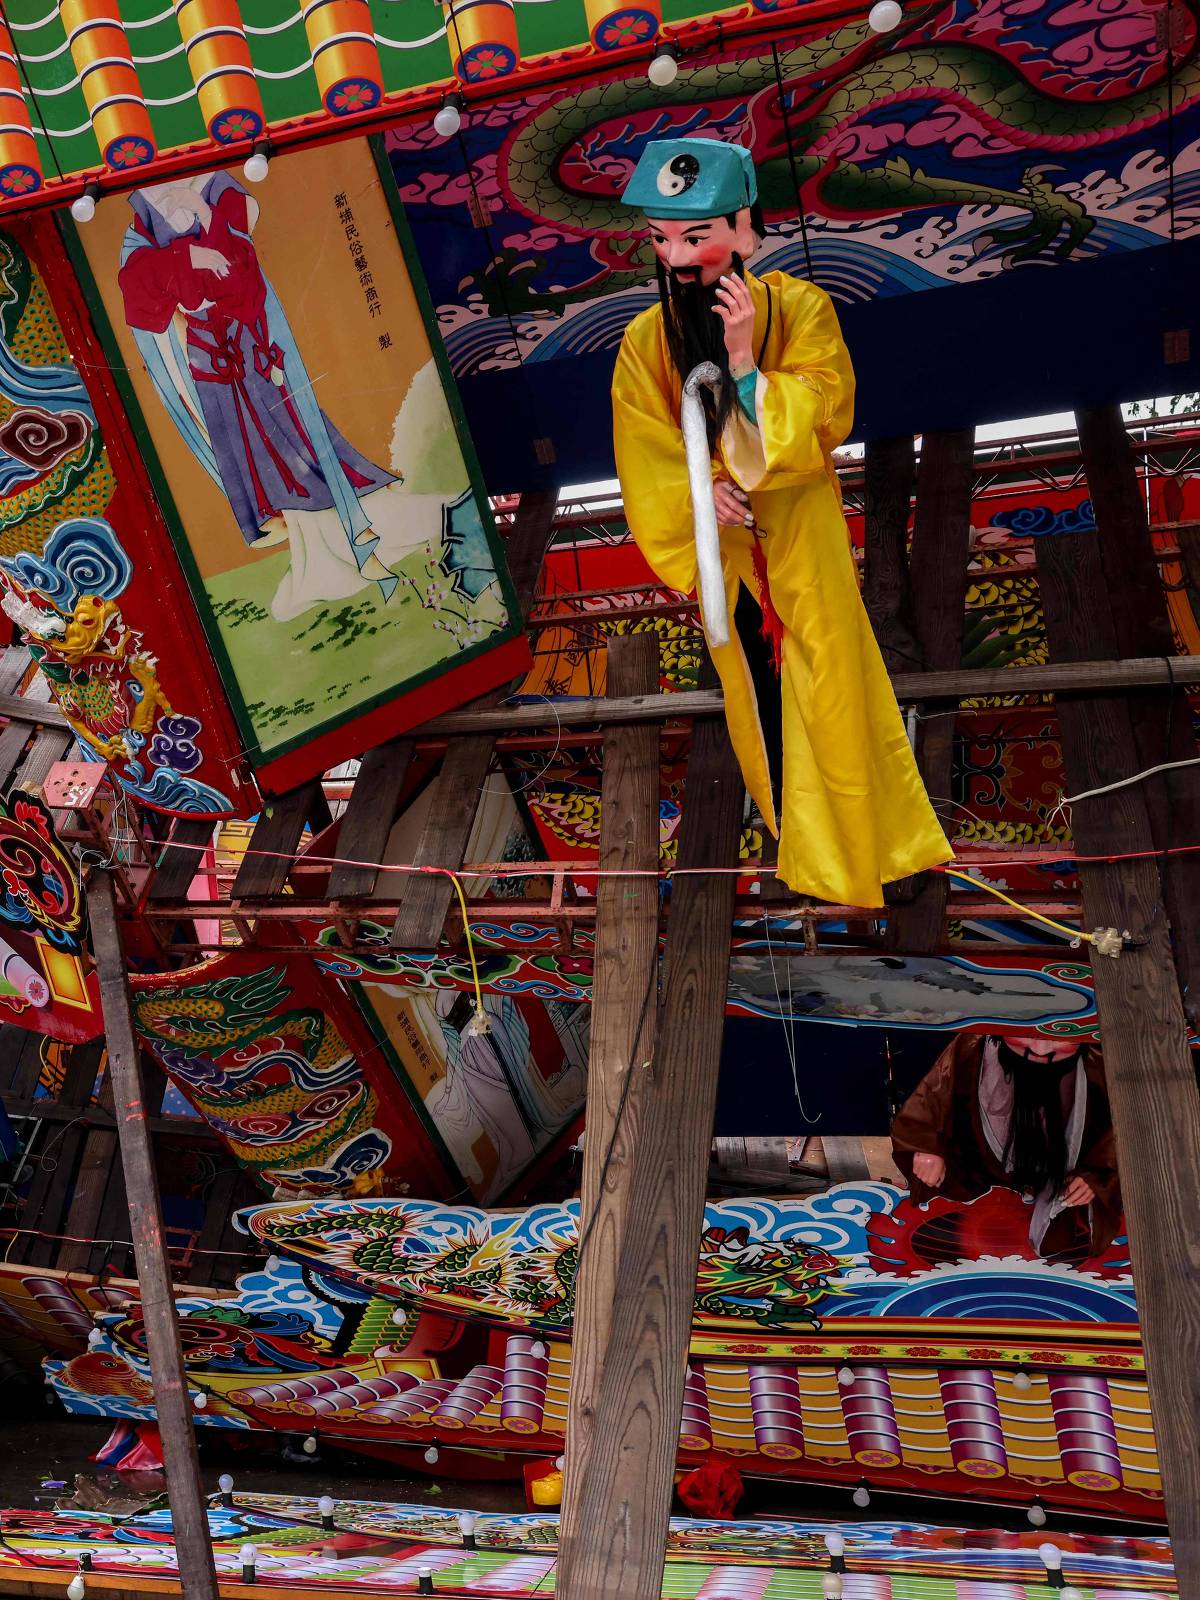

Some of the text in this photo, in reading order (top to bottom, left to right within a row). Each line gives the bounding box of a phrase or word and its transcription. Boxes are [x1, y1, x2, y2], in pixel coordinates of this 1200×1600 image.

[334, 192, 392, 351] 新埔民俗藝術商行 製
